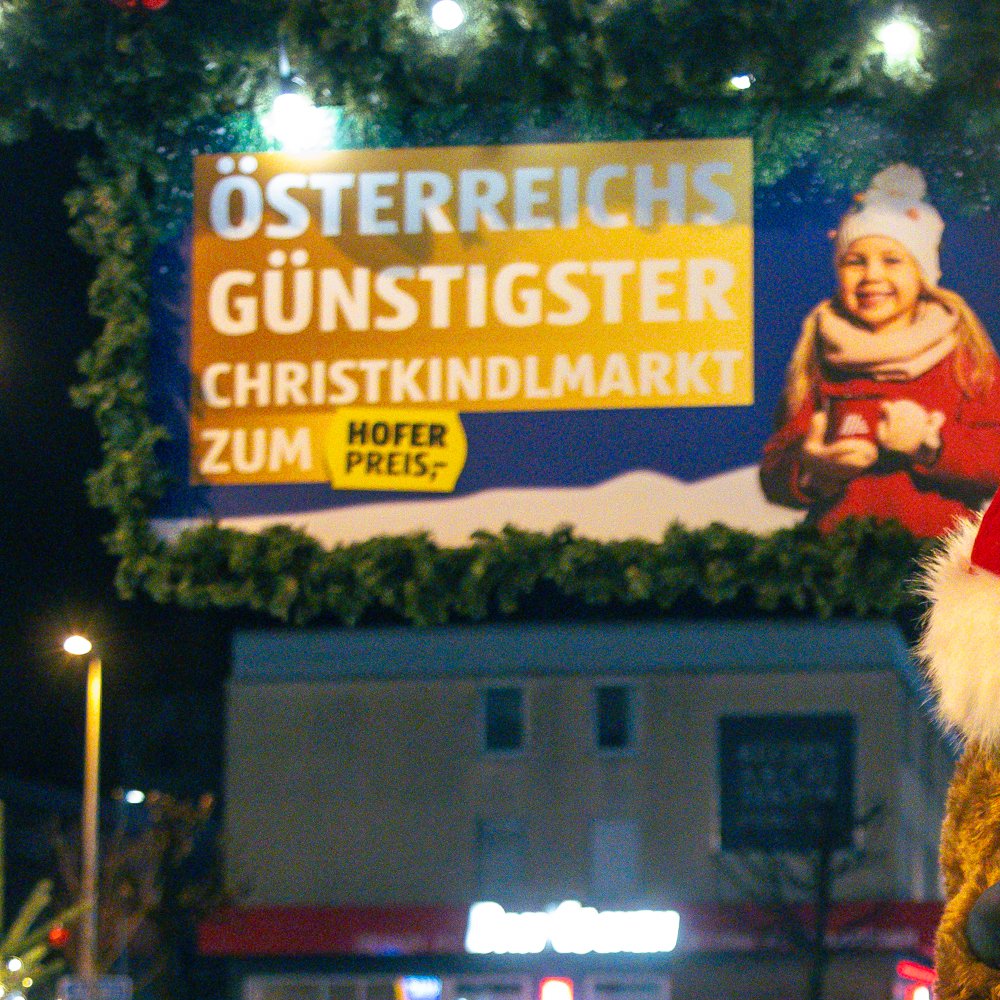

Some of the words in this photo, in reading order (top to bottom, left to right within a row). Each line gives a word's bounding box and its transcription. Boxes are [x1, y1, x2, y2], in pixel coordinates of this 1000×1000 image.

[209, 156, 737, 241] ÖSTERREICHS
[208, 248, 738, 336] GÜNSTIGSTER
[202, 350, 744, 408] CHRISTKINDLMARKT
[200, 428, 312, 475] ZUM
[347, 420, 447, 447] HOFER
